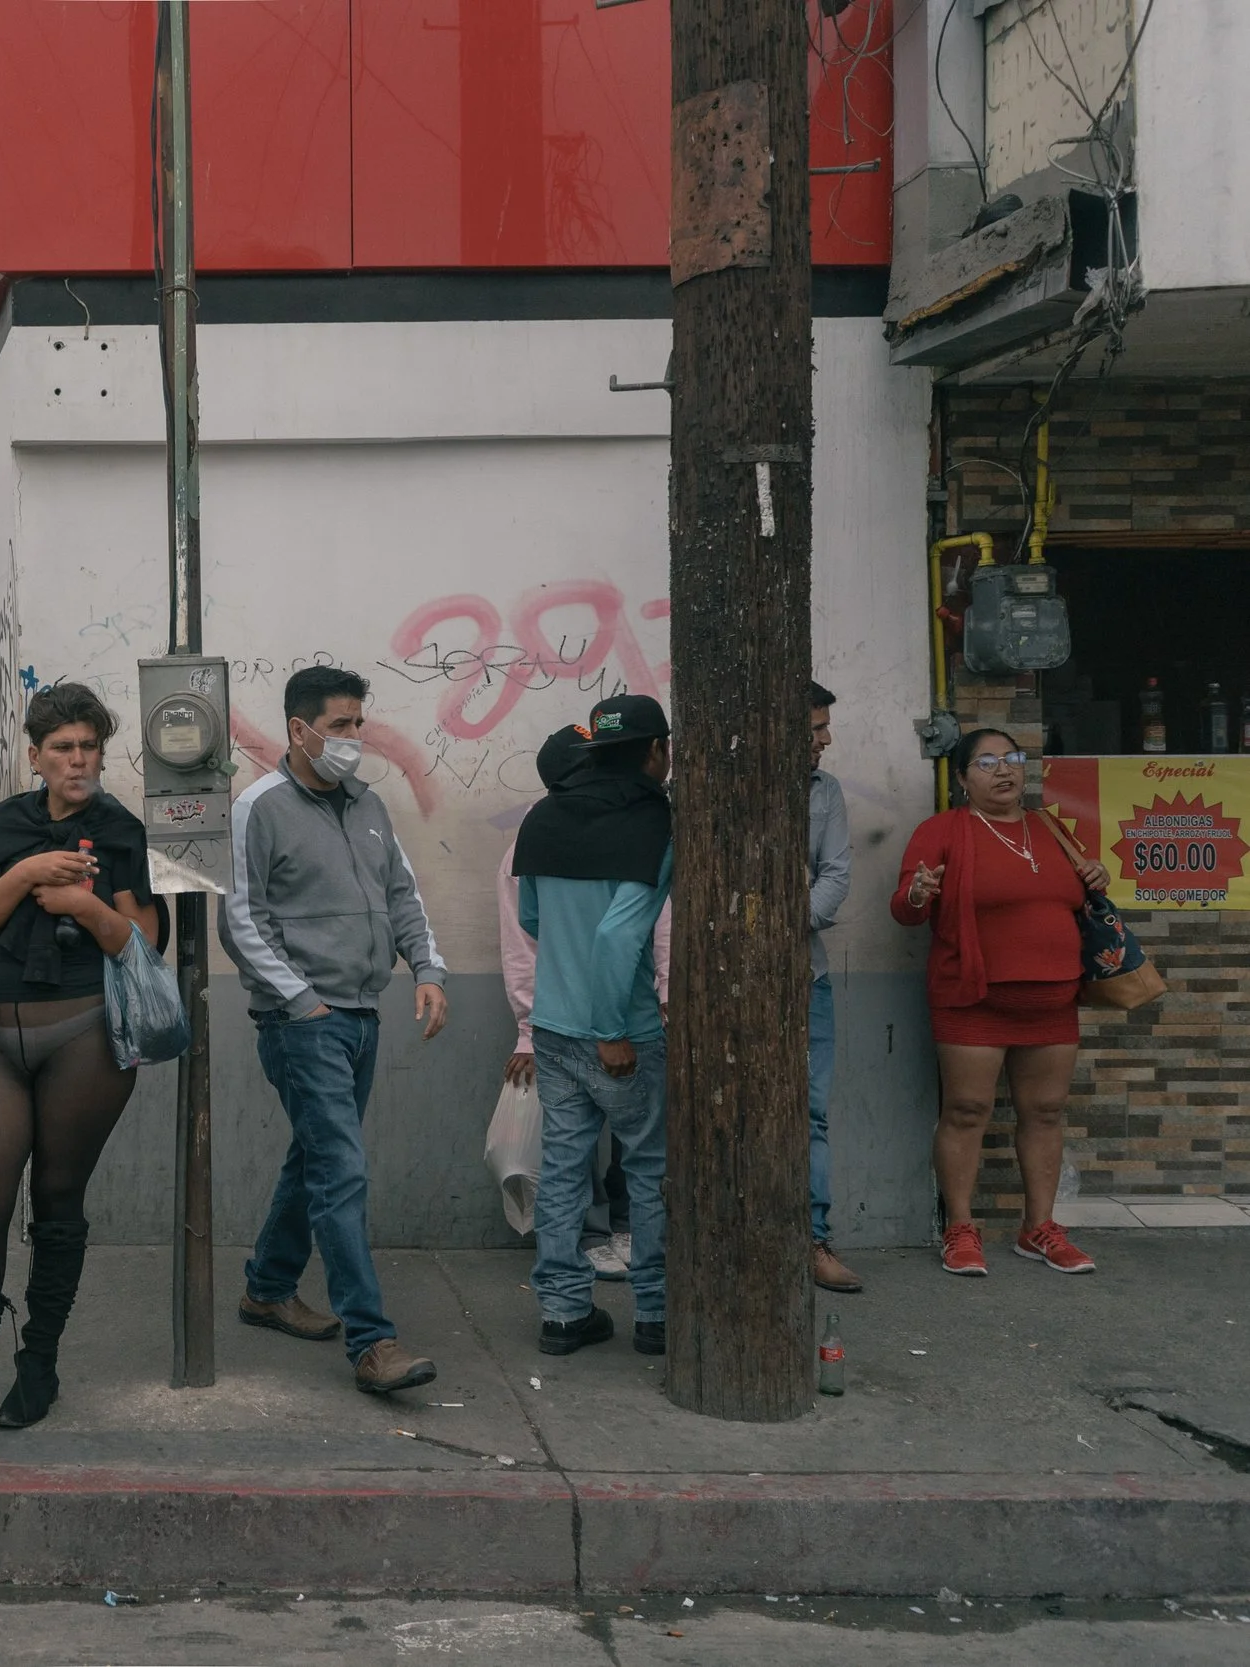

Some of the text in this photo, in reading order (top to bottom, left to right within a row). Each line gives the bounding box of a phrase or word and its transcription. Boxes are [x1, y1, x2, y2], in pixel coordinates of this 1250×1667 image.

[1142, 761, 1216, 782] Especial
[1145, 815, 1213, 827] ALBONDIGAS
[1126, 829, 1136, 838] EN
[1138, 829, 1175, 839] CHIPOTLE,
[1176, 829, 1199, 838] ARROZ
[1208, 829, 1231, 838] FRIJOL
[1134, 841, 1216, 875] $60.00
[1135, 889, 1227, 901] SOLO COMEDOR
